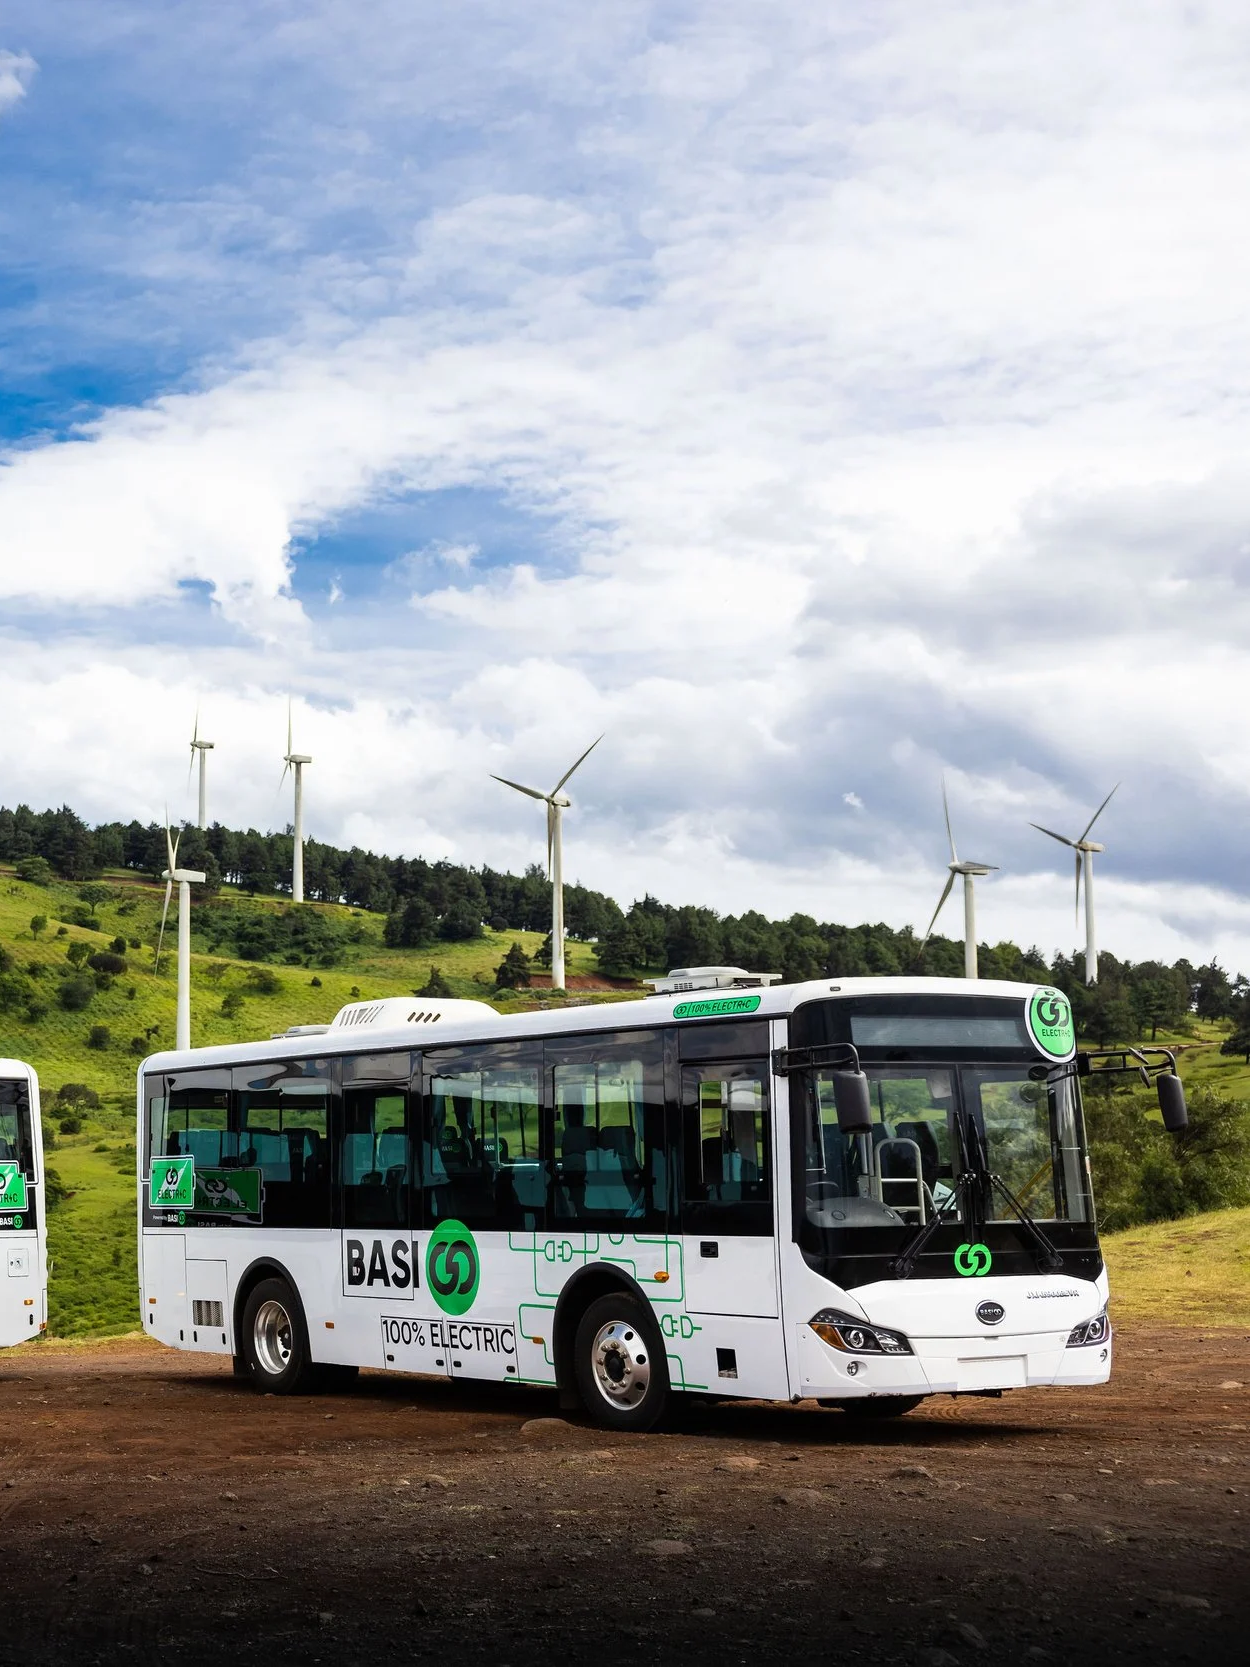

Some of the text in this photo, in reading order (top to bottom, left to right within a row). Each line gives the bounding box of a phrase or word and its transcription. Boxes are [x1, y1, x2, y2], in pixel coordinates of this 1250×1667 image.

[691, 1003, 710, 1013] 100%
[382, 1319, 515, 1355] 100% ELECTRIC
